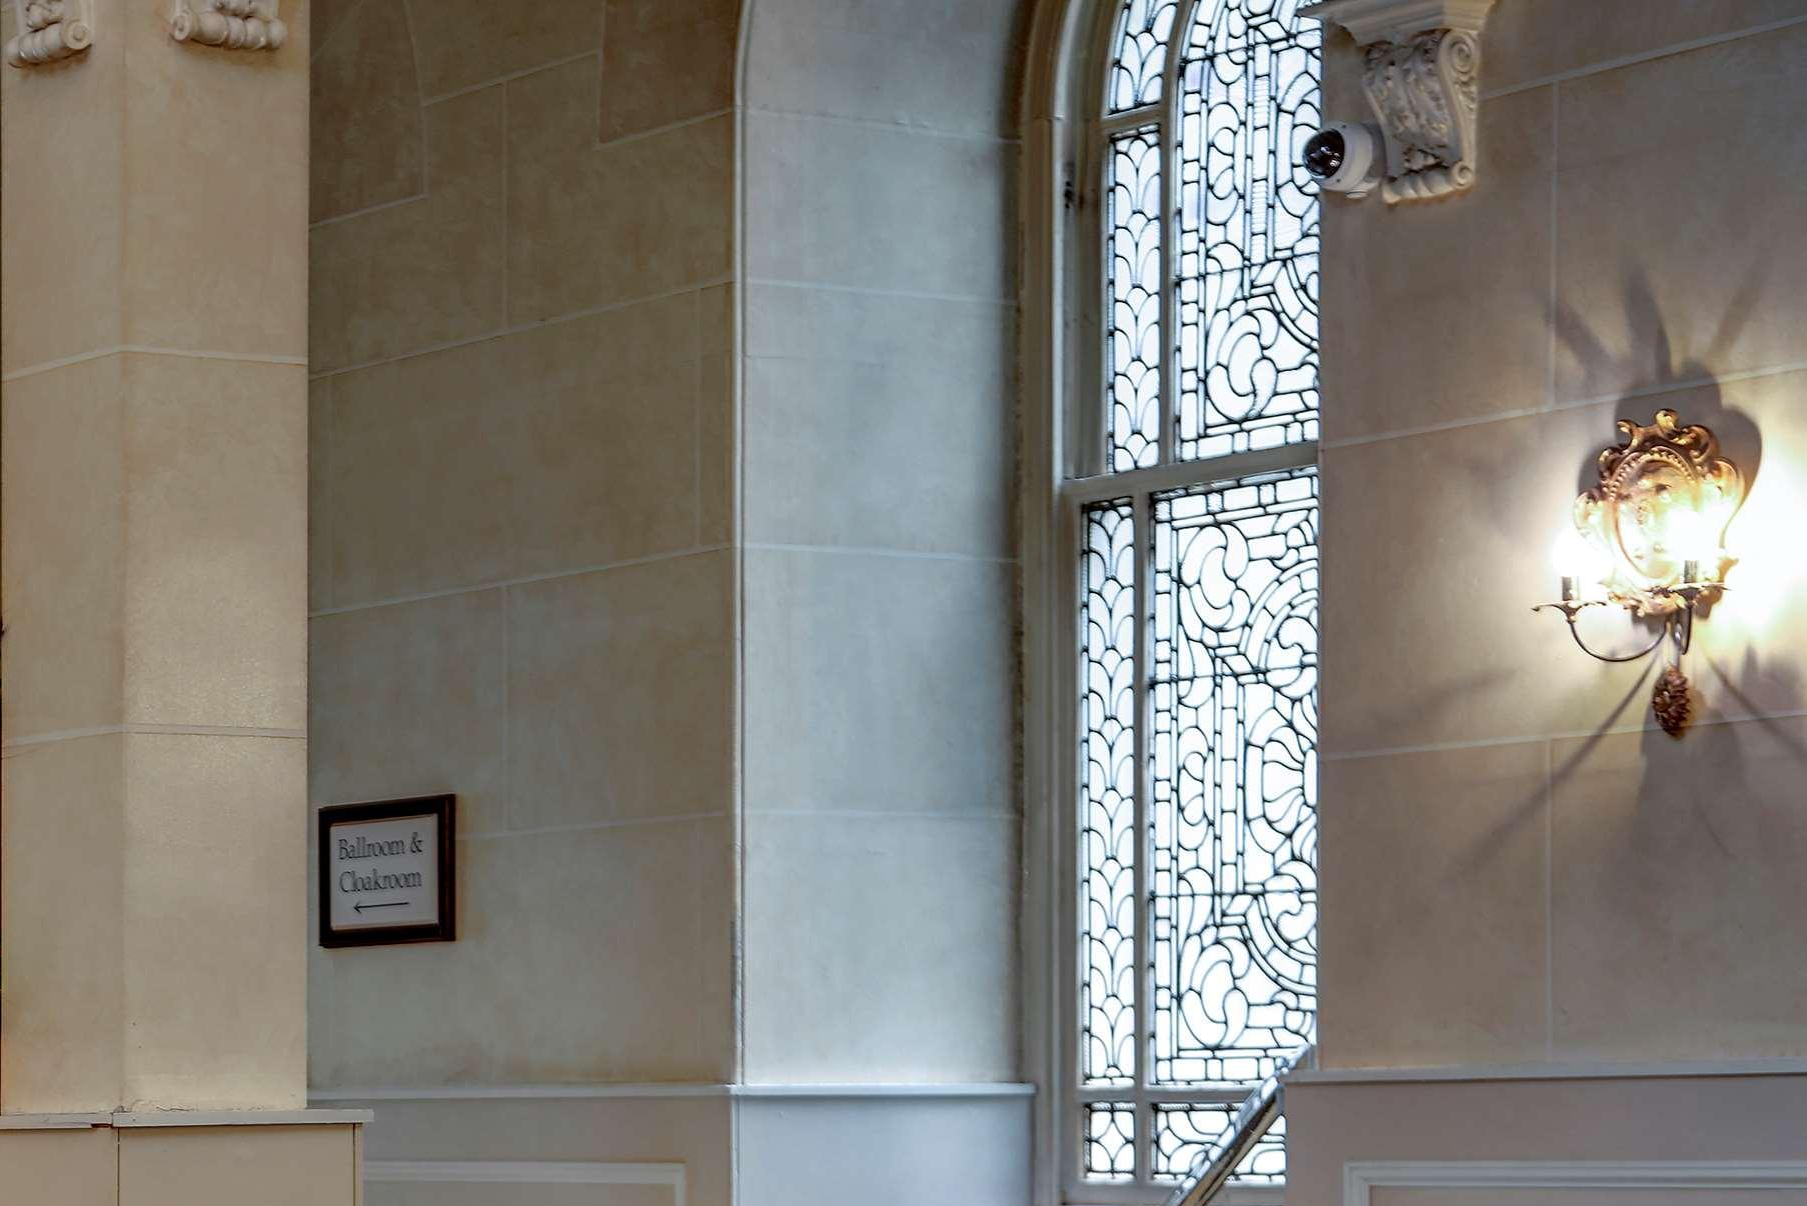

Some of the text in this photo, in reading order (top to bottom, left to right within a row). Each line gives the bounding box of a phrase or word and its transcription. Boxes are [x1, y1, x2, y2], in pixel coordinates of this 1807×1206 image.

[338, 831, 424, 860] Ballroom &
[339, 868, 423, 893] Cloakroom
